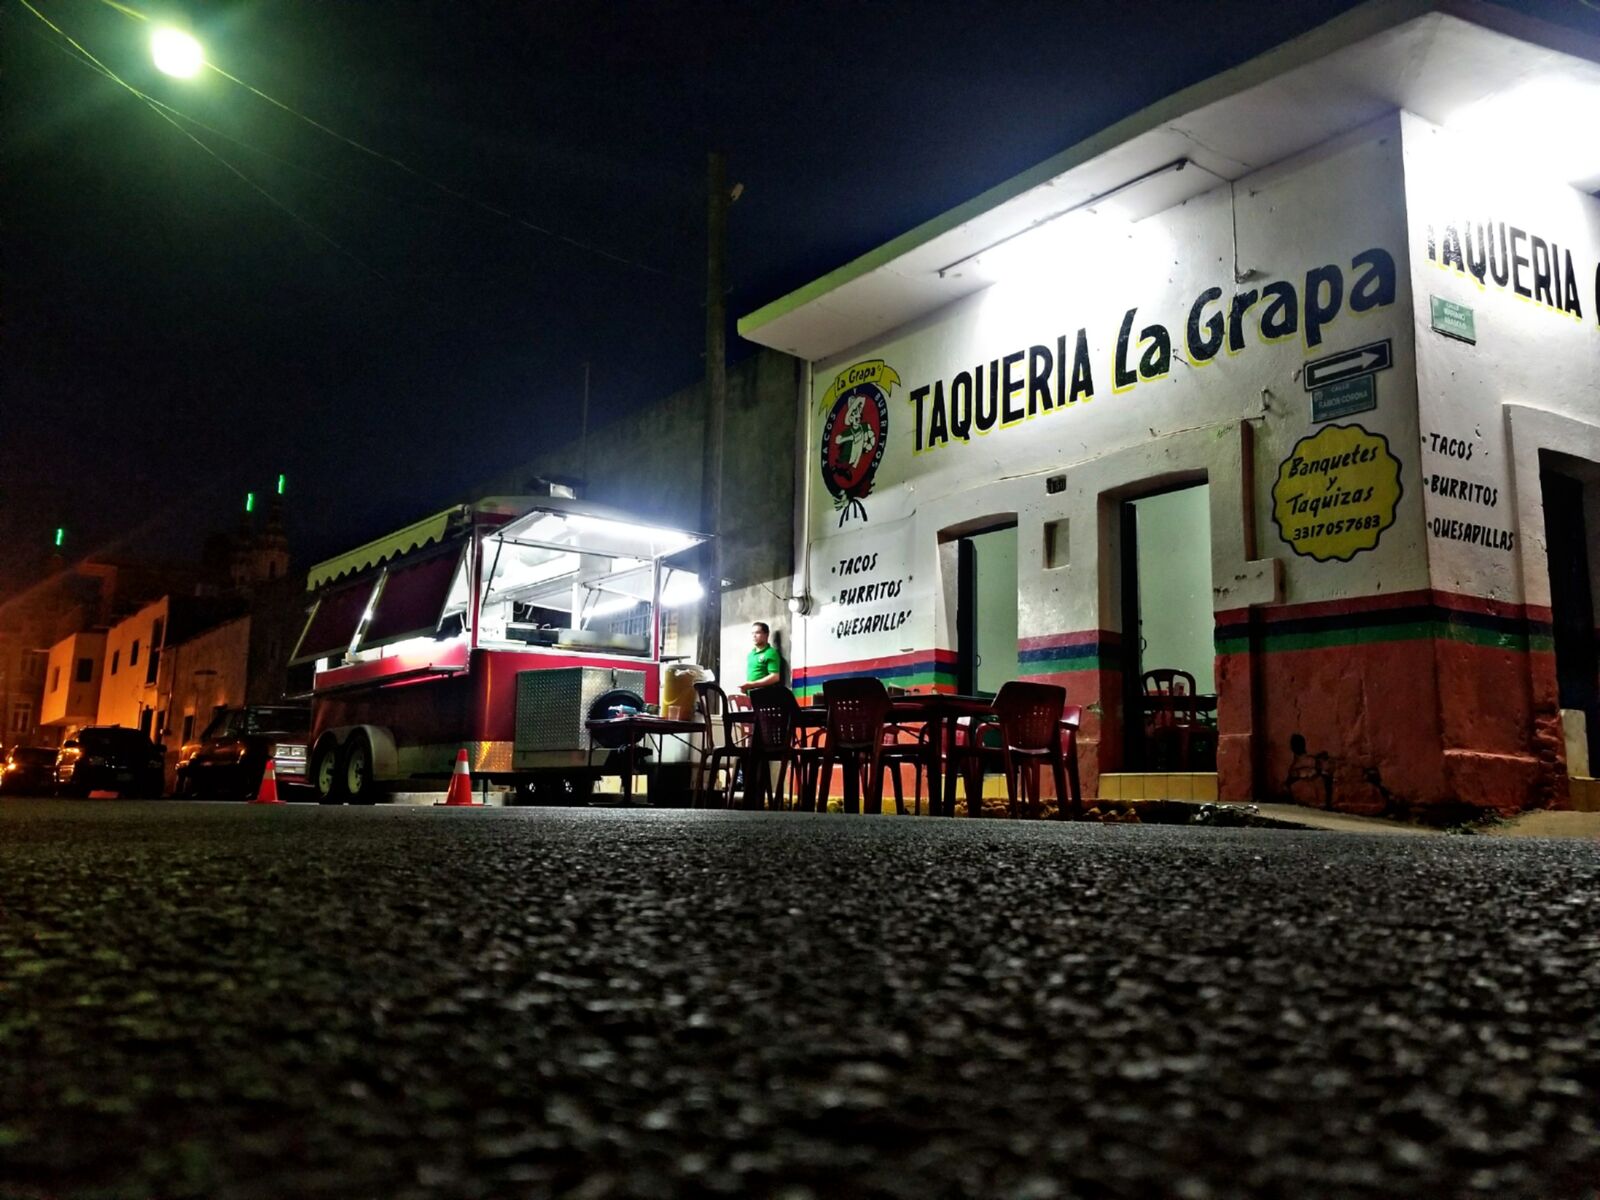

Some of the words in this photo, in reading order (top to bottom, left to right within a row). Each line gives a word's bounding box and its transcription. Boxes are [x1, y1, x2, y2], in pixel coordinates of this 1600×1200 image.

[909, 327, 1095, 452] TAQUERIA
[1113, 306, 1171, 388] La
[1187, 247, 1396, 361] Grapa
[822, 413, 837, 468] TACOS
[871, 392, 887, 468] BURRITOS
[1288, 444, 1378, 478] Banquetes
[1430, 433, 1473, 461] TACOS
[1326, 476, 1338, 491] y
[1430, 474, 1498, 507] BURRITOS
[1286, 486, 1374, 518] Taquizas
[1293, 515, 1380, 541] 3317057683
[1433, 517, 1514, 551] QUESADILLAS
[839, 552, 878, 576] TACOS
[839, 579, 903, 606] BURRITOS
